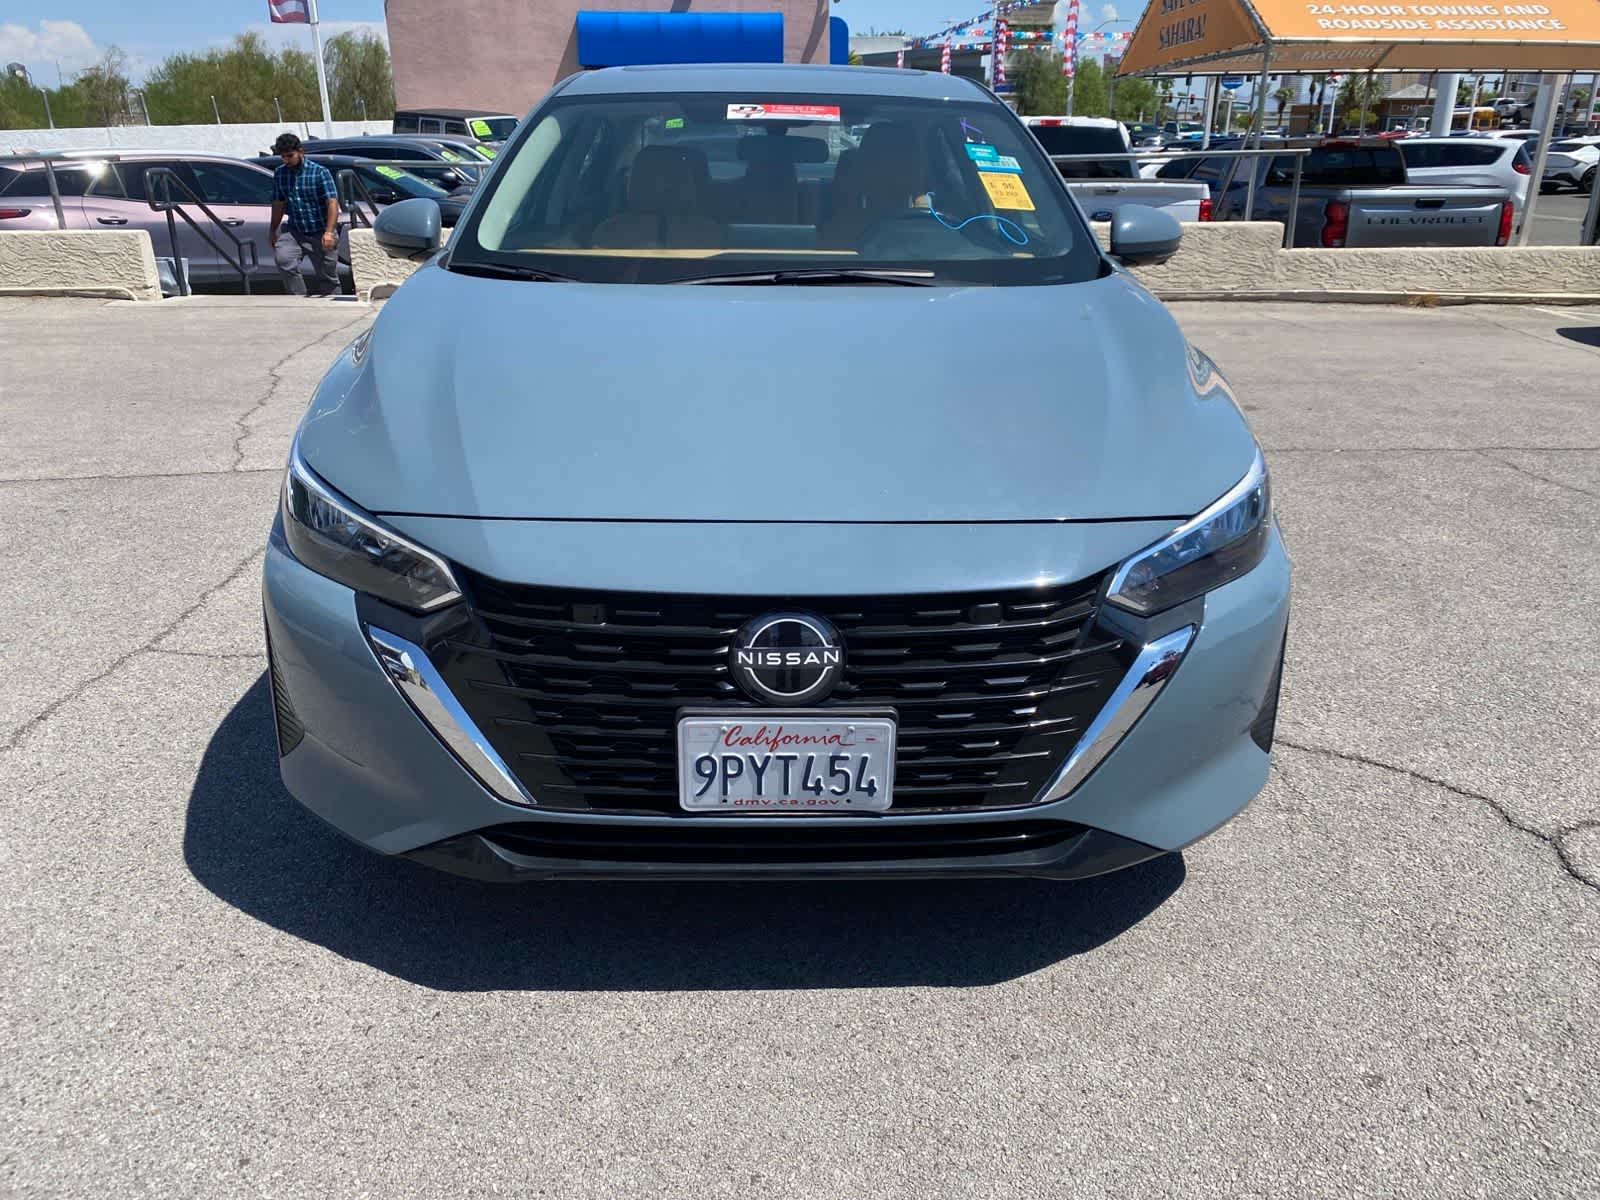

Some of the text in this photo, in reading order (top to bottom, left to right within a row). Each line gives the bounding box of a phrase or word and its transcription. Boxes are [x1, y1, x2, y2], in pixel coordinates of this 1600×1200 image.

[1306, 4, 1550, 15] 24-HOUR TOWING AND
[1318, 19, 1568, 30] ROADSIDE ASSISTANCE
[1158, 14, 1207, 50] SAHARA!
[1365, 215, 1486, 225] CHEVROLET
[737, 650, 840, 666] NISSAN
[724, 725, 857, 751] California
[694, 753, 879, 797] 9PYT454
[733, 798, 840, 806] dmv.ca.gov
